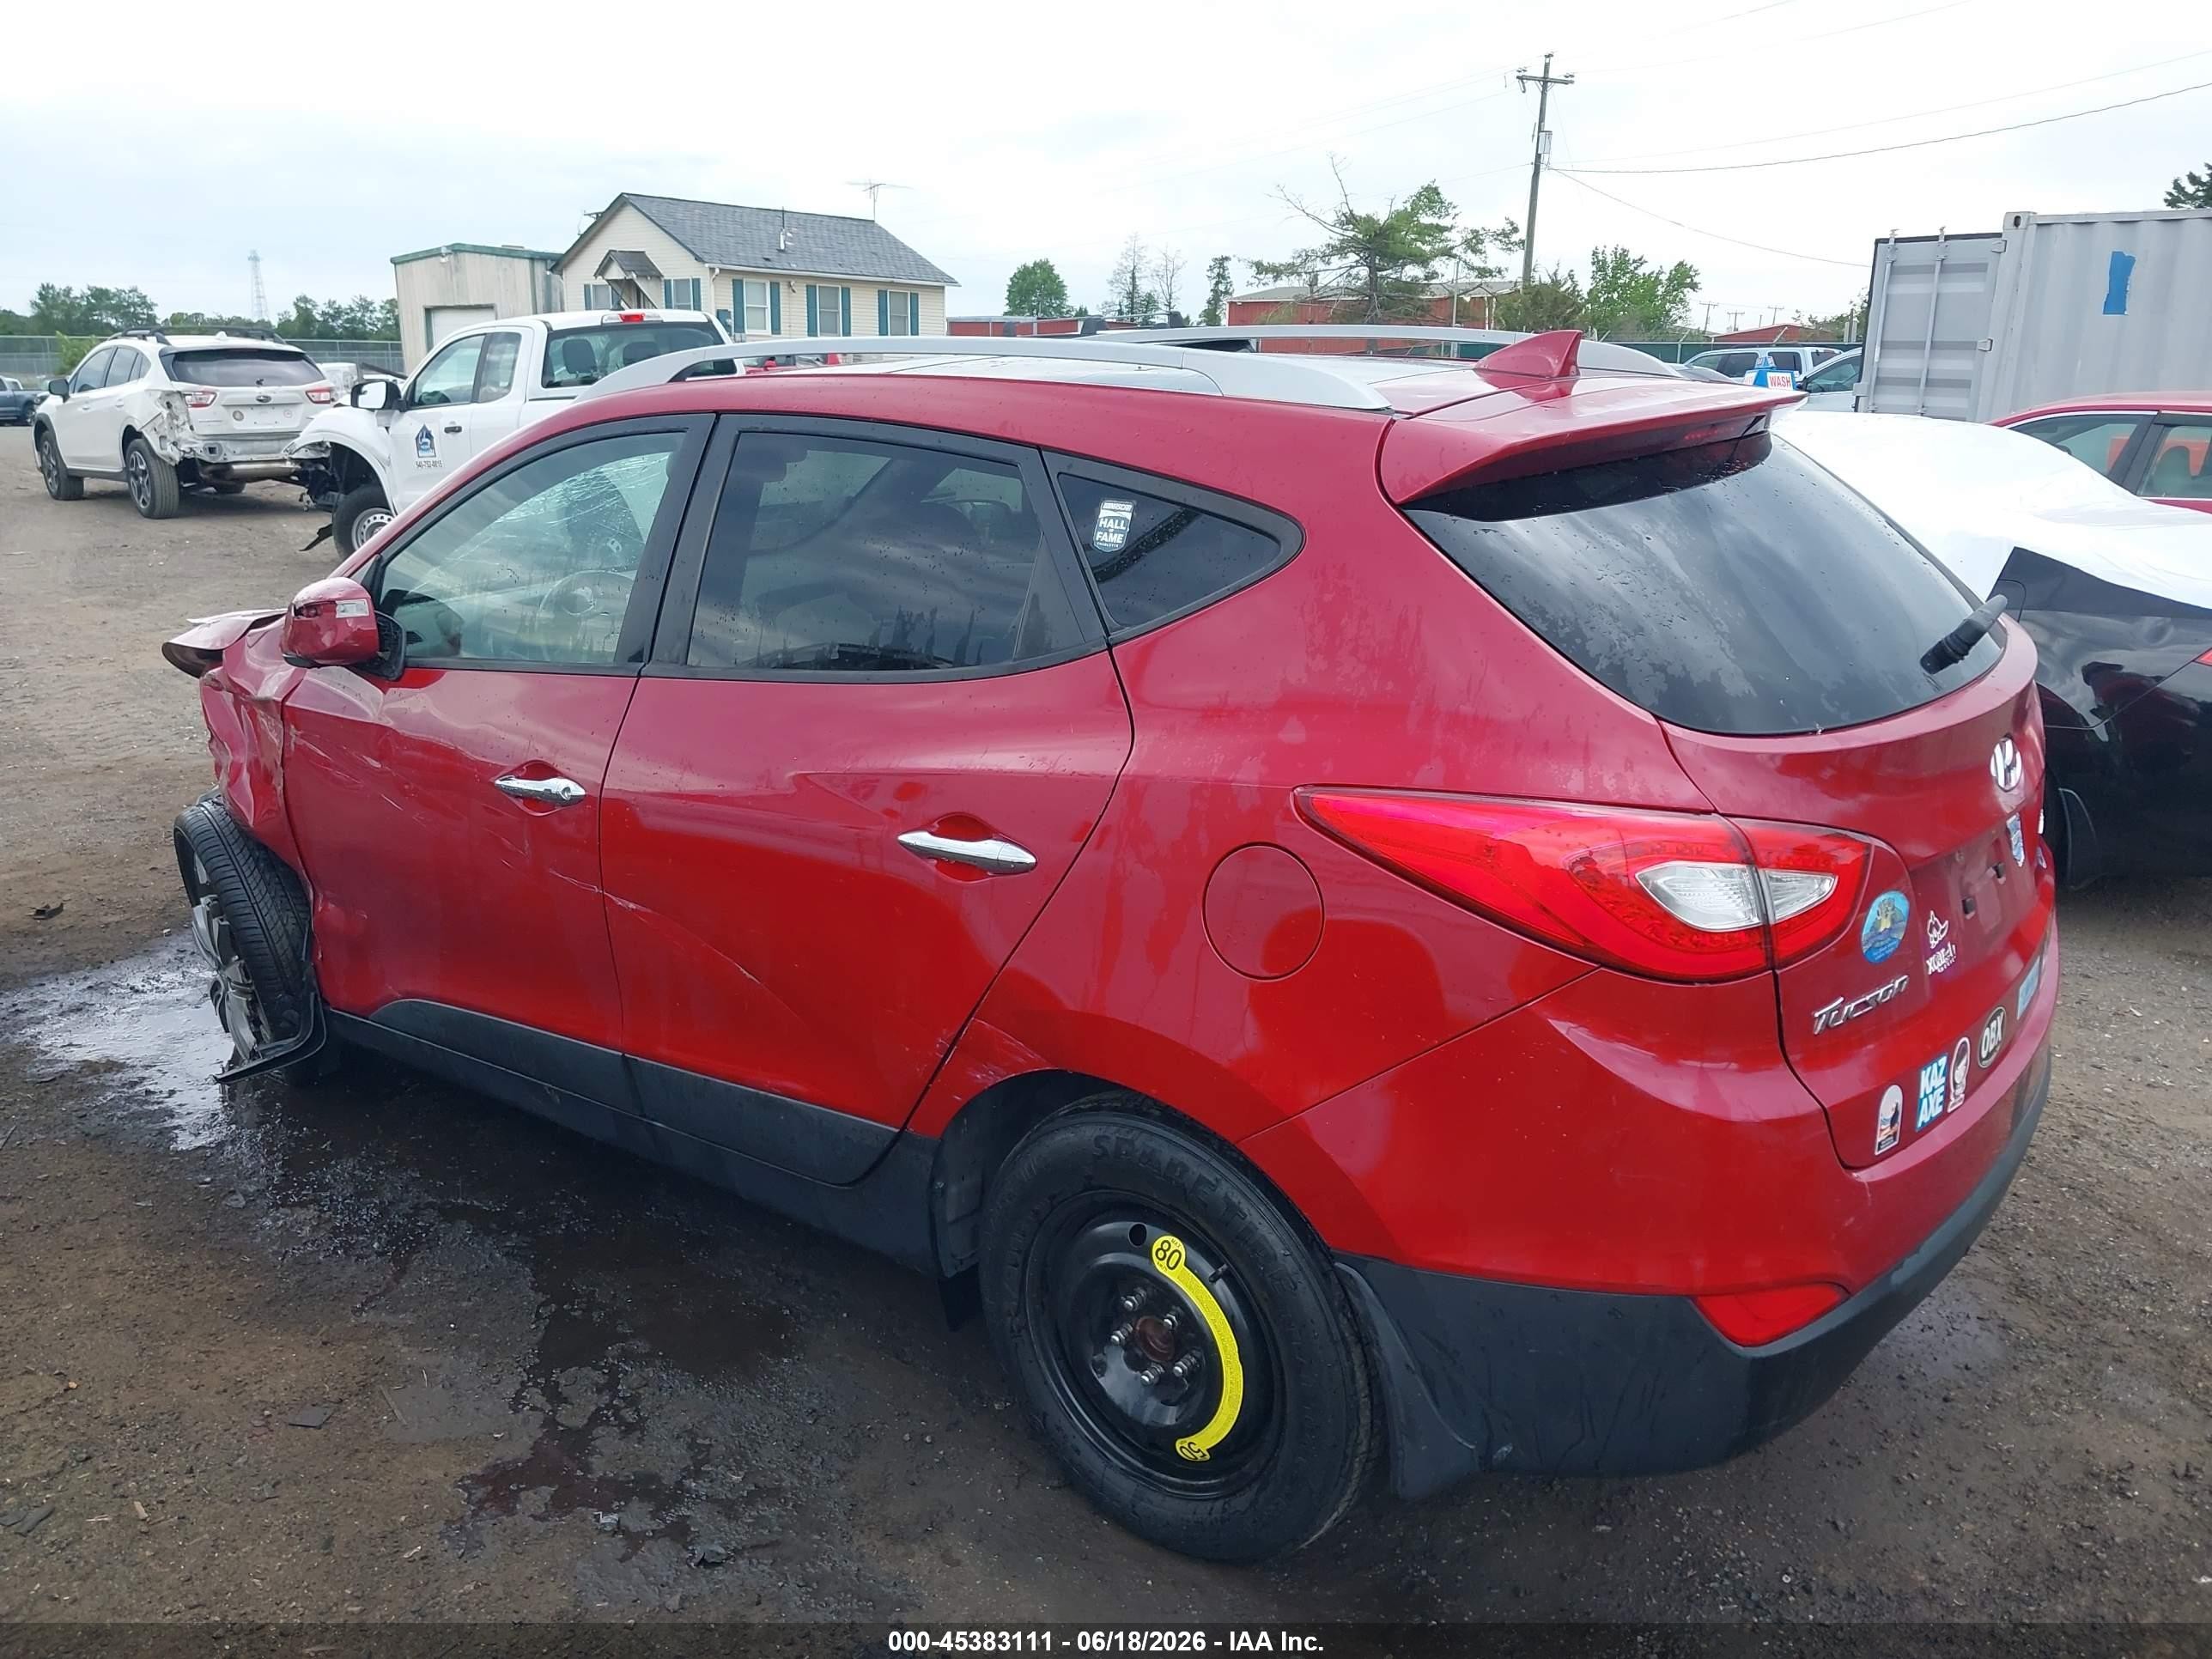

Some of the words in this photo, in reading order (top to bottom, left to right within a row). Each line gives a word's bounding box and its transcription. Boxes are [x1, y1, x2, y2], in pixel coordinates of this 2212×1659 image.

[1769, 375, 1791, 388] WASH
[1099, 518, 1126, 530] HALL
[1096, 532, 1124, 543] FAME
[1981, 1012, 2004, 1059] OBX
[1920, 1055, 1947, 1098] KAZ
[1917, 1085, 1944, 1127] AXE
[1155, 1239, 1182, 1270] 80
[1180, 1442, 1206, 1460] 50
